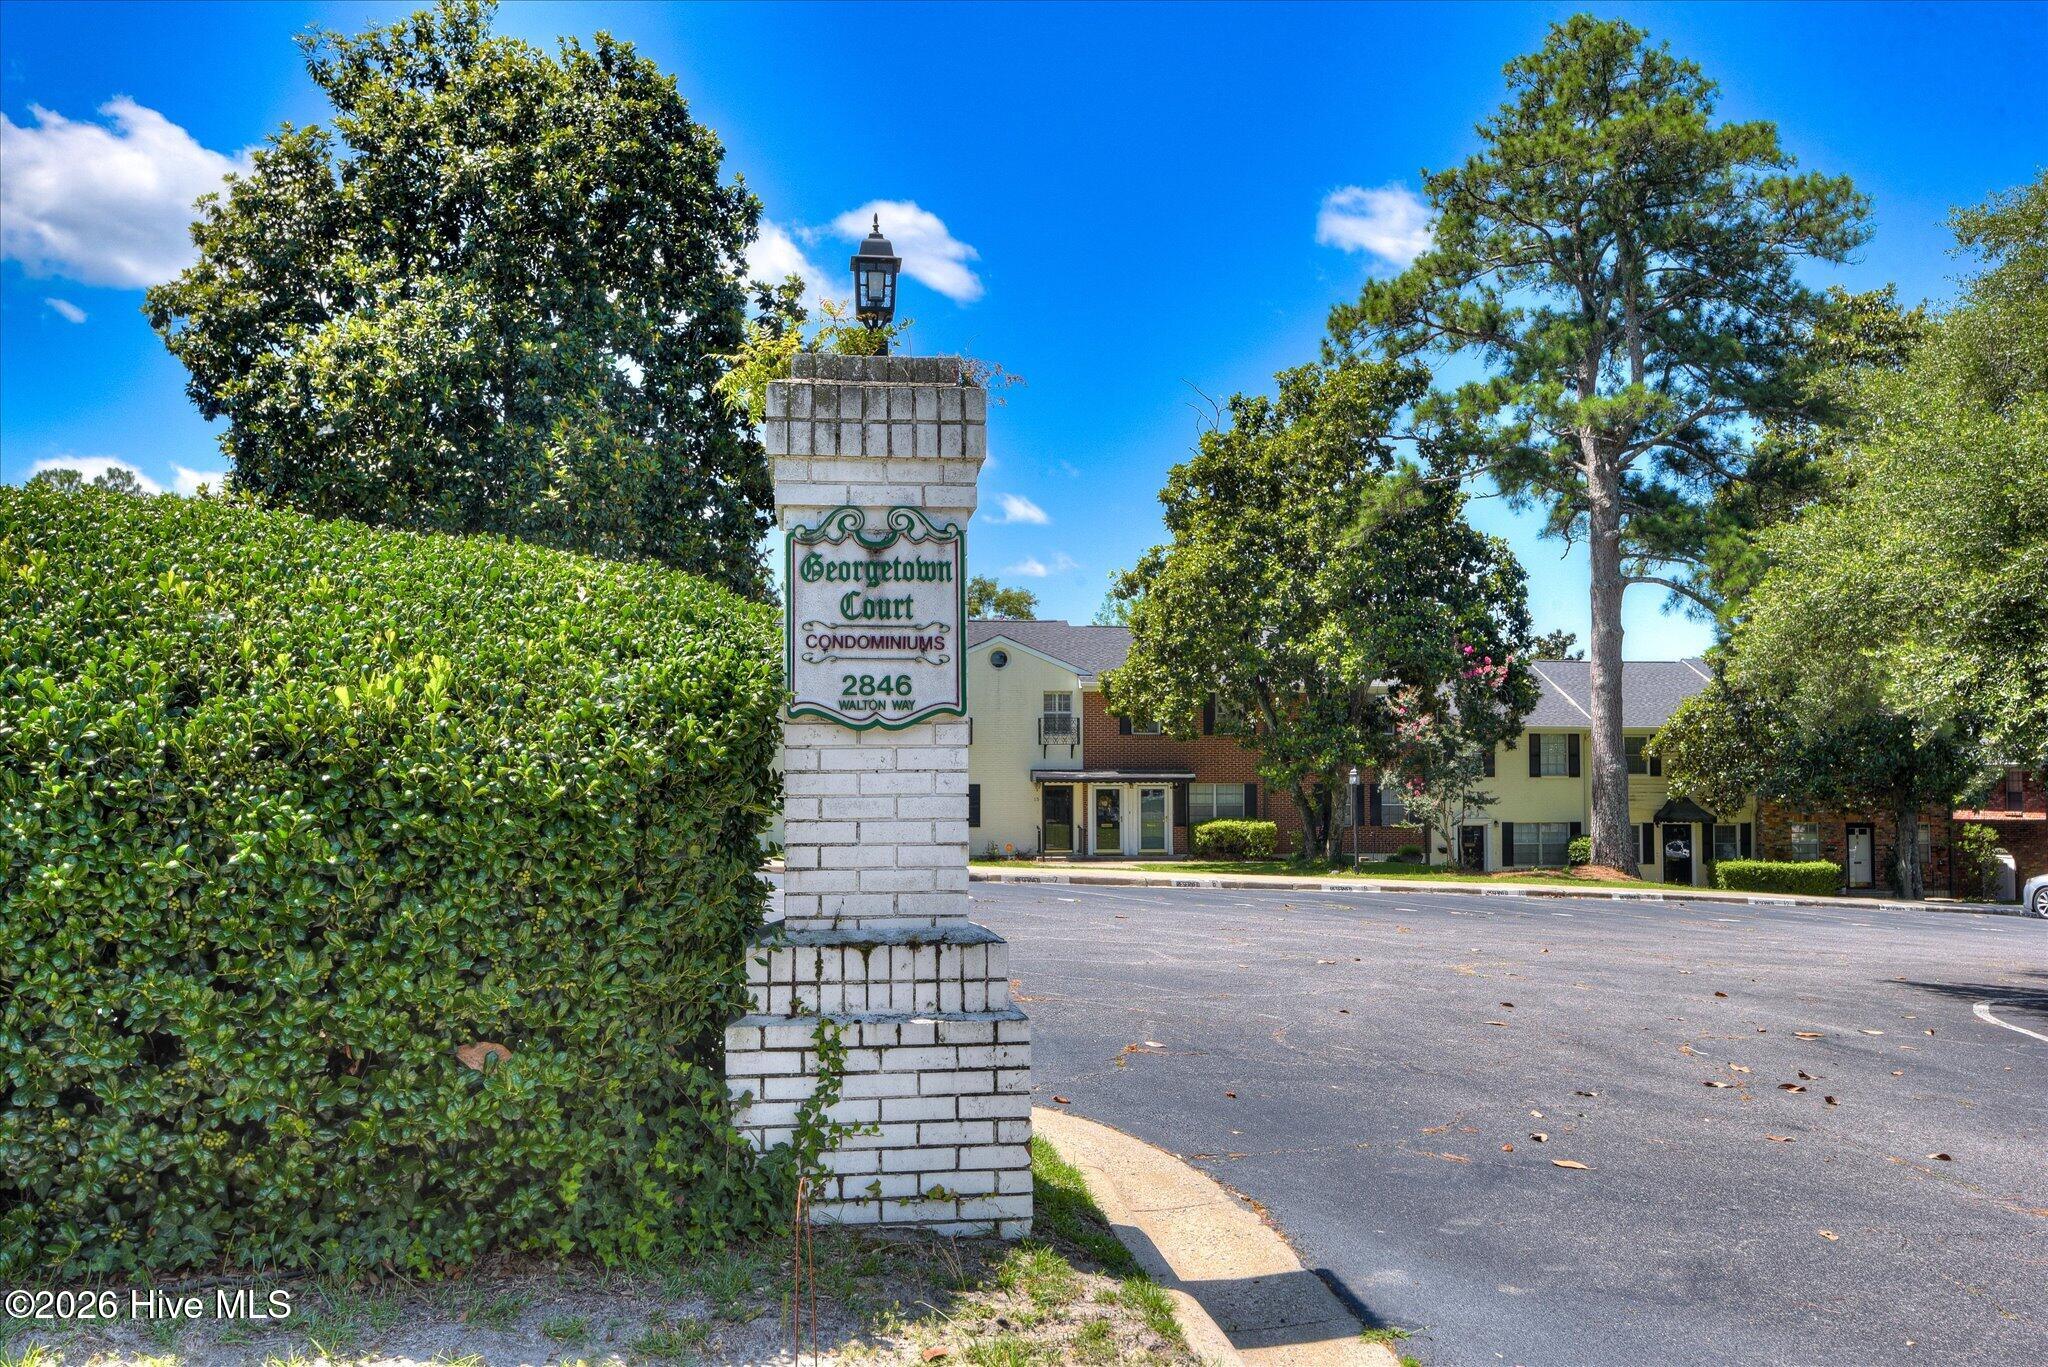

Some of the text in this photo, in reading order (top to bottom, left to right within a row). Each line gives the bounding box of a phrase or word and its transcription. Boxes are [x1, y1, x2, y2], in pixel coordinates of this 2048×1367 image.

[800, 552, 952, 587] Georgetown
[840, 591, 914, 620] Court
[806, 634, 945, 651] CONDOMINIUMS
[842, 675, 912, 696] 2846
[839, 700, 916, 711] WALTON WAY
